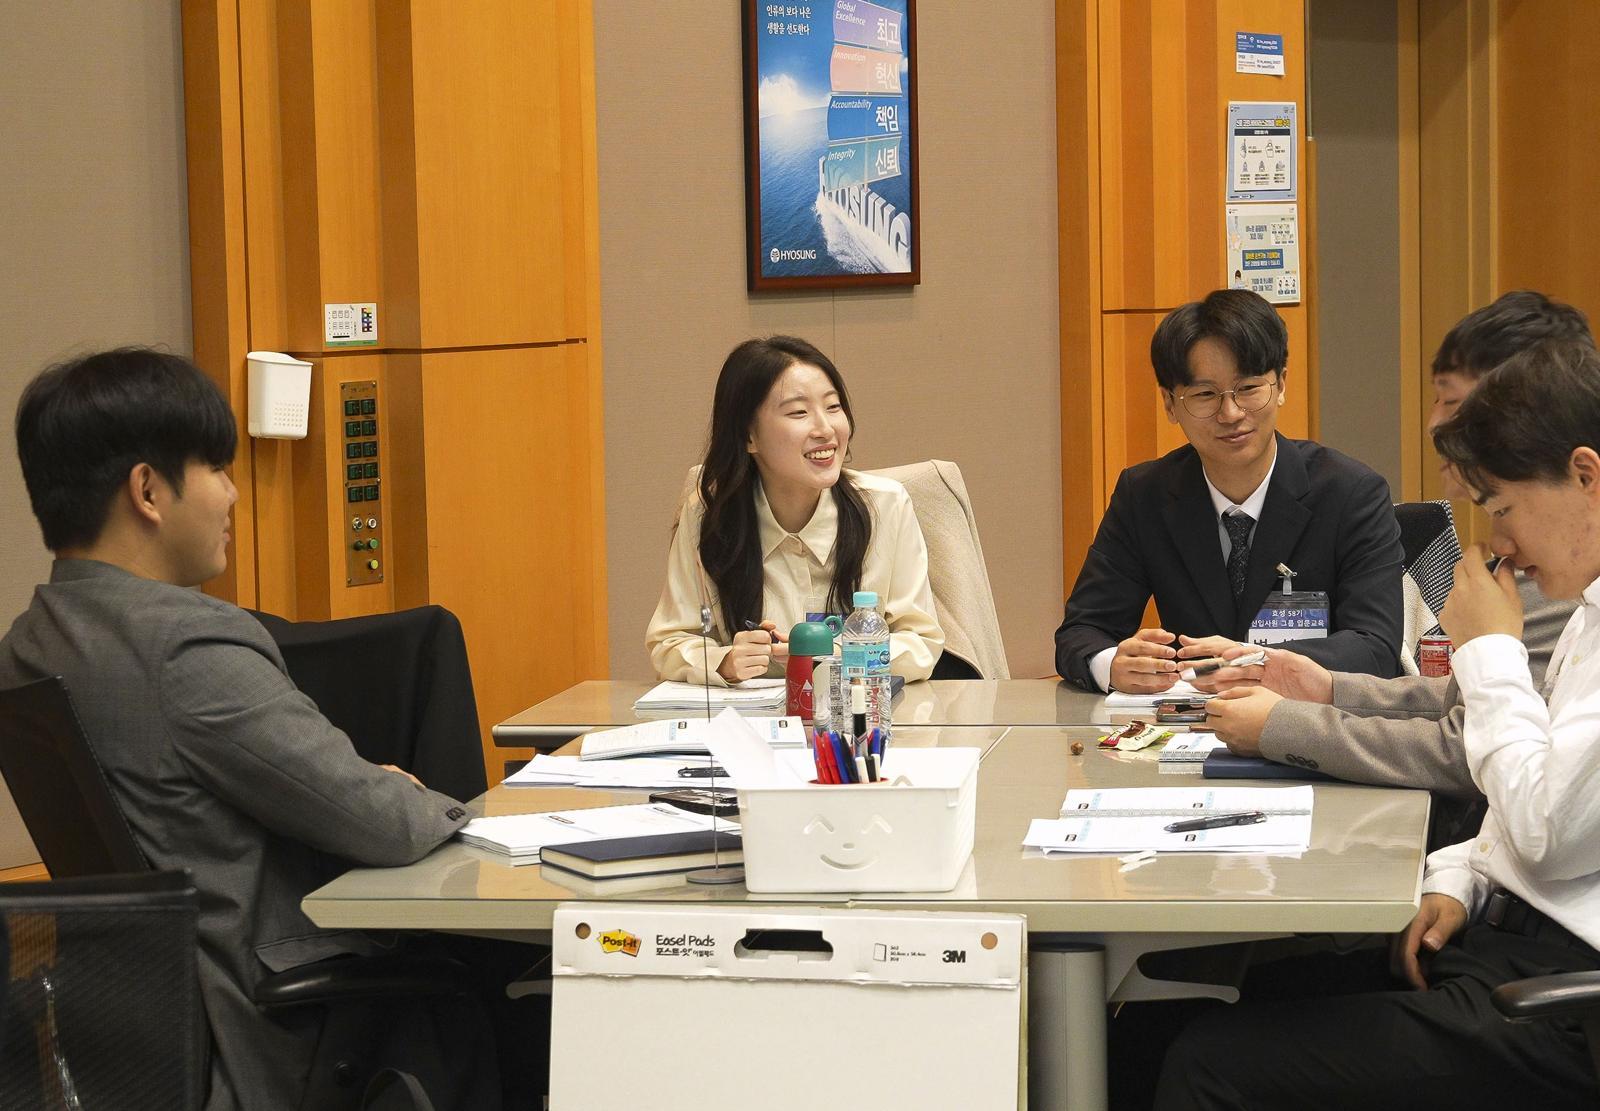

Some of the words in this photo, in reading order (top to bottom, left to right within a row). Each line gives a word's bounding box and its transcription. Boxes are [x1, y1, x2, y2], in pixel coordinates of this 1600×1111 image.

[766, 5, 785, 17] 인류의
[786, 6, 799, 18] 보다
[800, 6, 812, 18] 나은
[837, 0, 856, 13] Global
[835, 11, 866, 26] Excellence
[767, 22, 785, 34] 생활을
[786, 22, 810, 36] 선도한다
[877, 18, 900, 47] 최고
[833, 49, 866, 62] Innovation
[875, 62, 900, 90] 혁신
[830, 100, 872, 110] Accountability
[875, 105, 899, 132] 책임
[828, 148, 856, 161] Integrity
[875, 146, 899, 175] 신뢰
[780, 249, 817, 260] HYOSUNG
[1272, 609, 1286, 617] 효성
[1288, 609, 1303, 617] 58기
[1251, 619, 1278, 628] 신입사원
[1280, 619, 1294, 628] 그룹
[1296, 619, 1325, 628] 입문교육
[602, 936, 637, 948] Post-it
[656, 934, 686, 946] Easel
[688, 934, 715, 946] Pads
[942, 950, 966, 963] 3M
